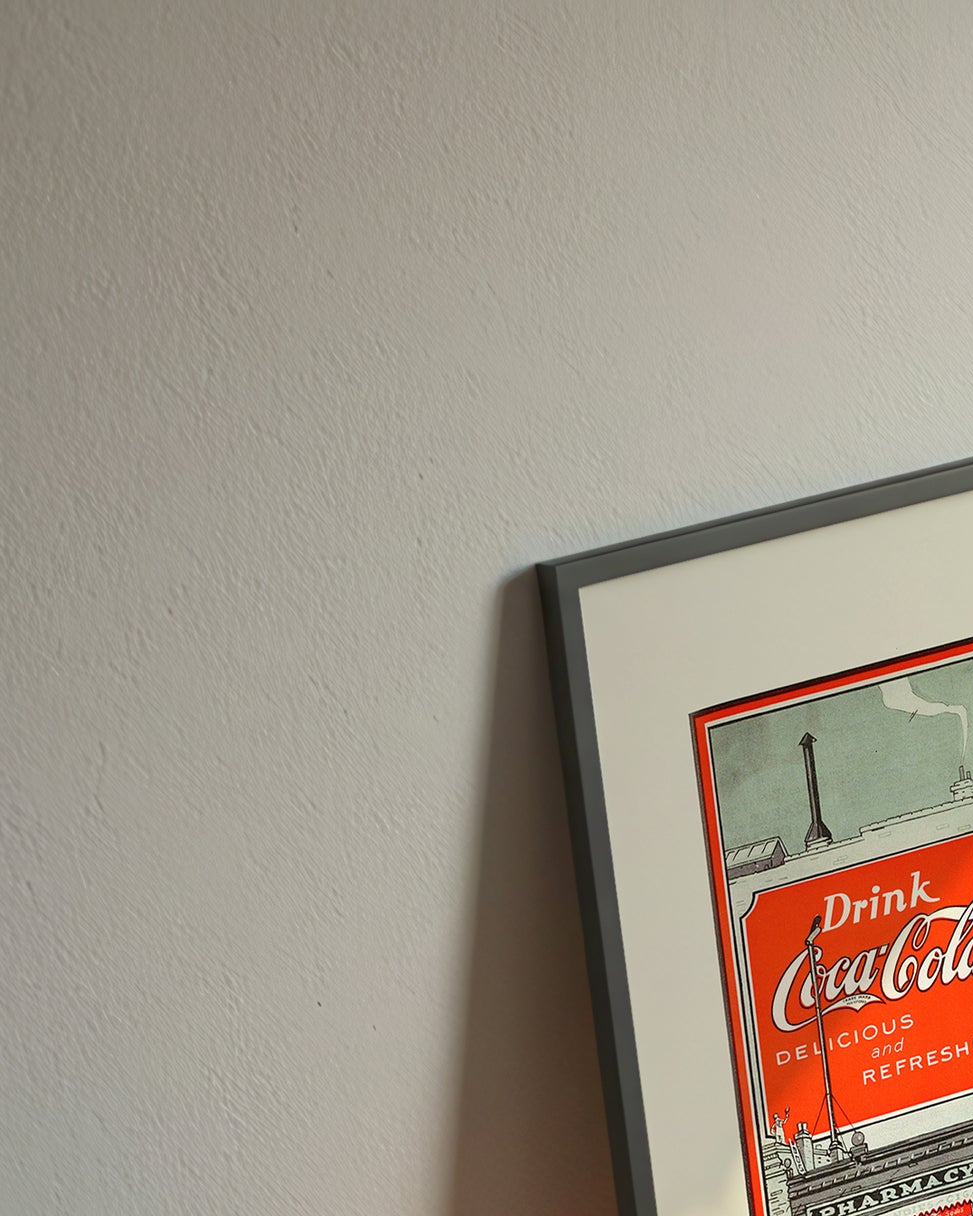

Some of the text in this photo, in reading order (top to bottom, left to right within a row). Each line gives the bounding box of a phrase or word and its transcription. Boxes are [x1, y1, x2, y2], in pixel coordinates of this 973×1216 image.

[822, 870, 941, 933] Drink
[776, 1014, 914, 1066] DELICIOUS
[871, 1037, 905, 1059] and
